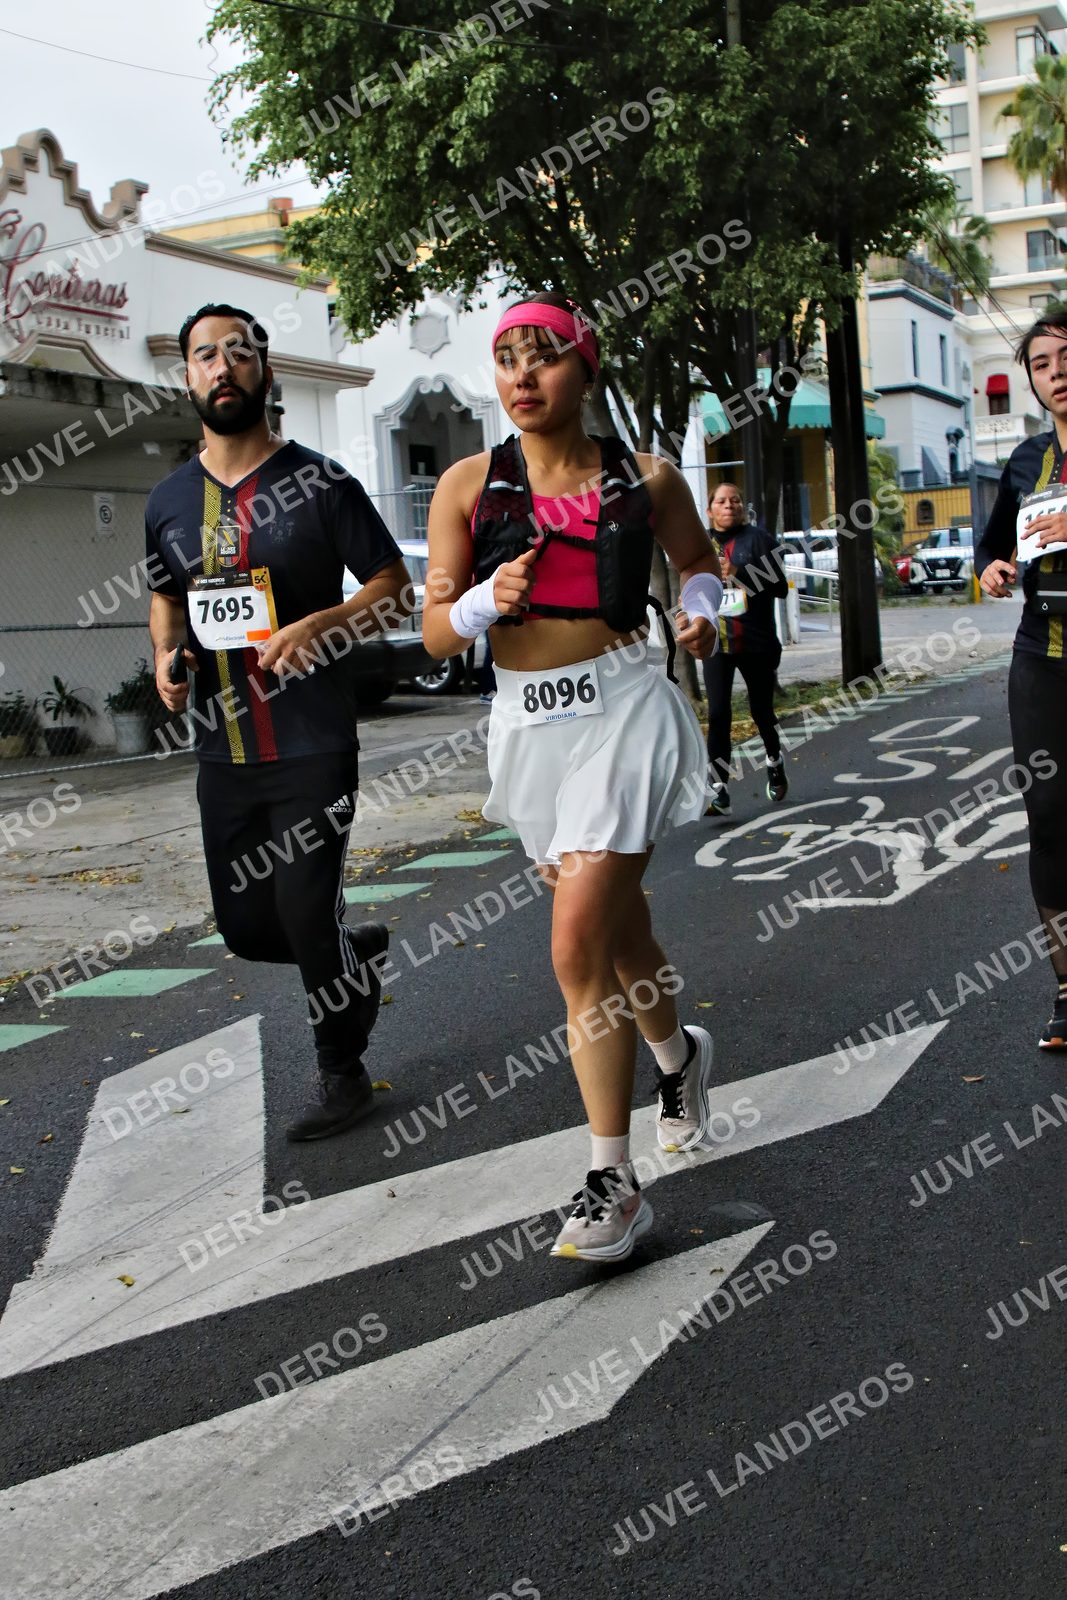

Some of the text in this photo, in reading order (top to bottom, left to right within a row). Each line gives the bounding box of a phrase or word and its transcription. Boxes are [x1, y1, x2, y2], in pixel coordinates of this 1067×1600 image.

[254, 574, 267, 585] 5K
[197, 595, 254, 624] 7695
[523, 672, 596, 713] 8096
[545, 711, 577, 721] VIRIDIANA
